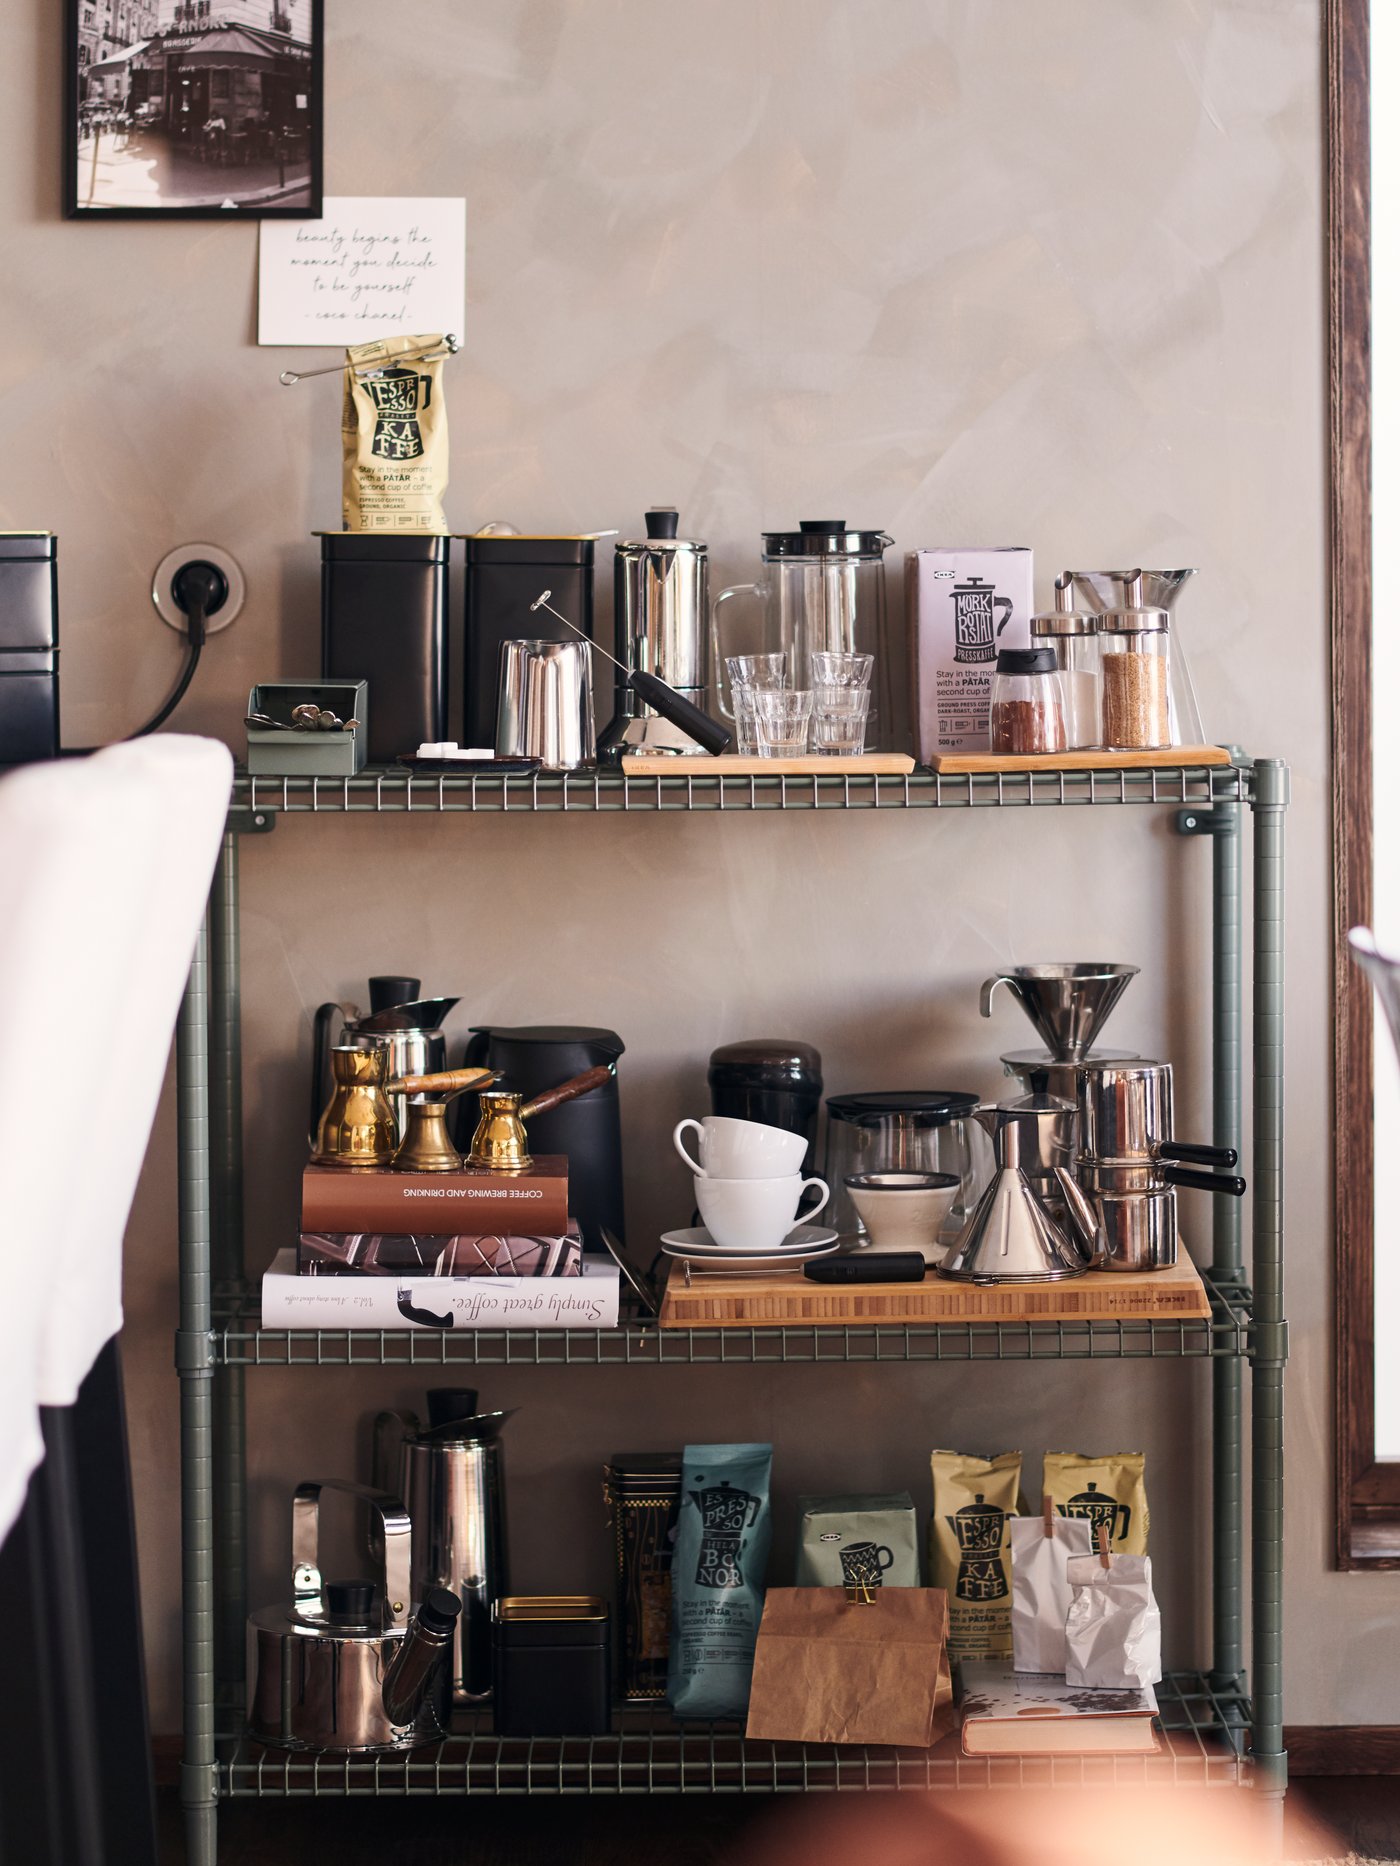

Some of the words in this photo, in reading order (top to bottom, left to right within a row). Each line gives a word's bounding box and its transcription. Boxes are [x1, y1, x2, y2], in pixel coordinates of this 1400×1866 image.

[296, 228, 347, 253] beauty
[352, 228, 402, 255] begins
[408, 225, 432, 243] the
[290, 252, 348, 267] moment
[350, 259, 382, 277] you
[386, 251, 438, 270] decide
[313, 275, 327, 292] to
[333, 277, 349, 291] be
[351, 276, 416, 301] yourself
[315, 311, 349, 320] coco
[359, 466, 375, 474] Stay
[957, 648, 994, 661] PRESSKAFFE
[937, 688, 964, 696] second
[403, 1189, 444, 1197] DRINKING
[447, 1189, 466, 1197] AND
[468, 1189, 507, 1197] BREWING
[509, 1190, 543, 1198] COFFEE
[503, 1293, 544, 1313] great
[548, 1293, 605, 1321] Simply
